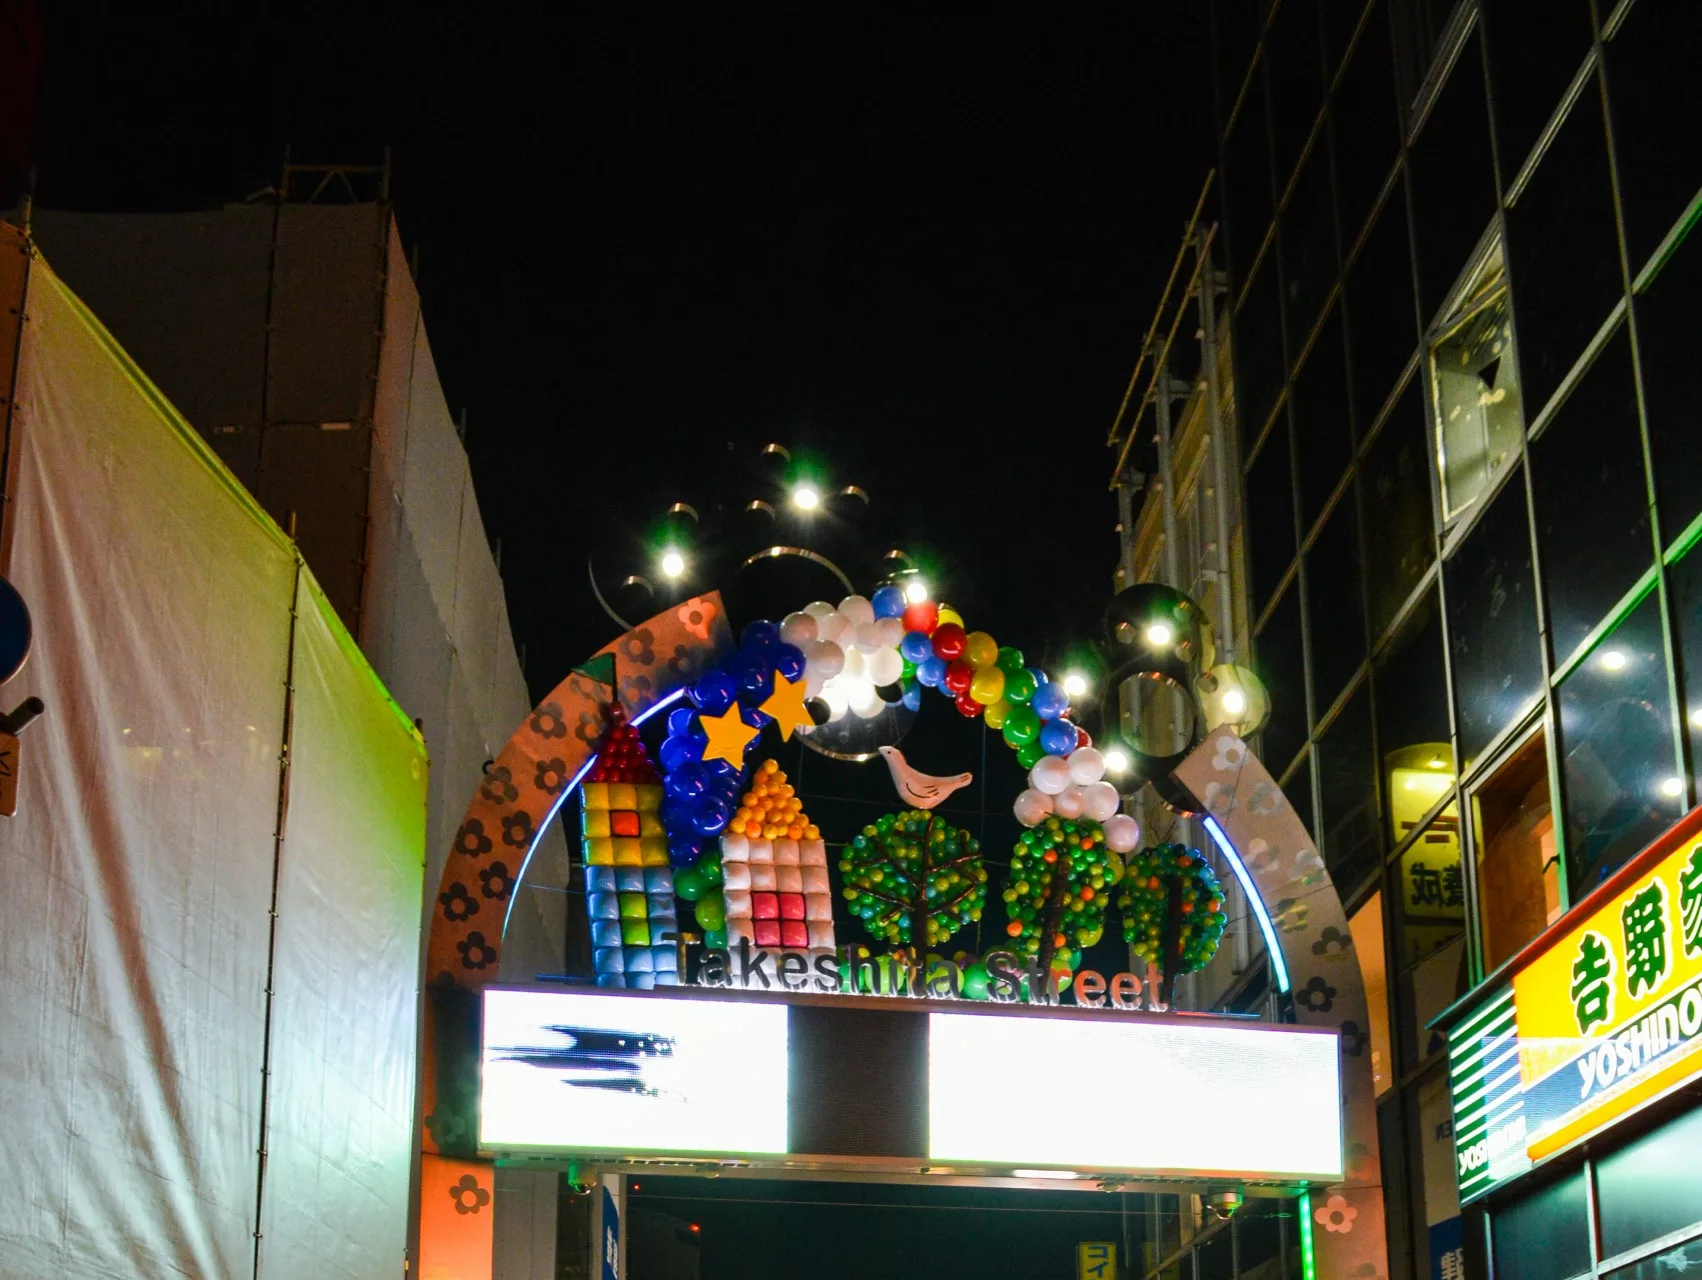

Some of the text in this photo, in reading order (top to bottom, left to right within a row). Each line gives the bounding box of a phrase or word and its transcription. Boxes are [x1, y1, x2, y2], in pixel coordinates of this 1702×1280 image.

[661, 931, 1169, 1012] Takeshita Street
[1577, 983, 1702, 1099] YOSHINO
